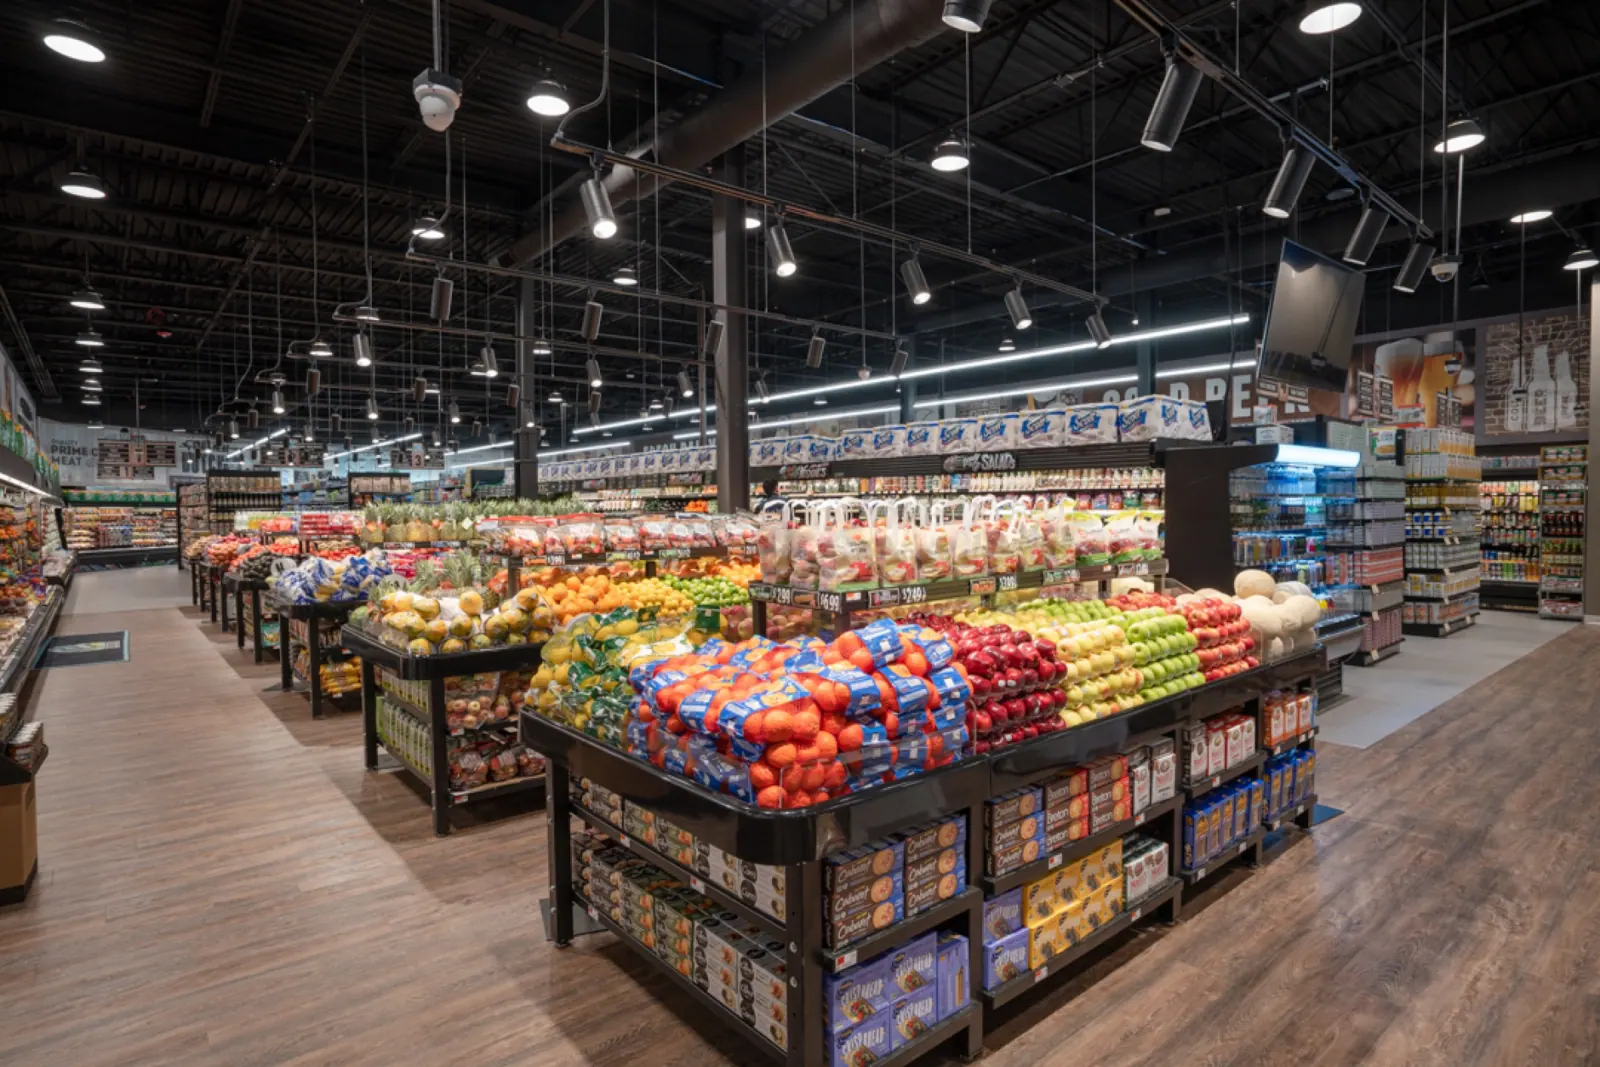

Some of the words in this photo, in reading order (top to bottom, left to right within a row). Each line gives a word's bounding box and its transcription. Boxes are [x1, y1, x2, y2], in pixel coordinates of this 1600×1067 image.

[1534, 389, 1547, 425] BEER
[51, 445, 88, 456] PRIME
[52, 456, 82, 466] MEAT
